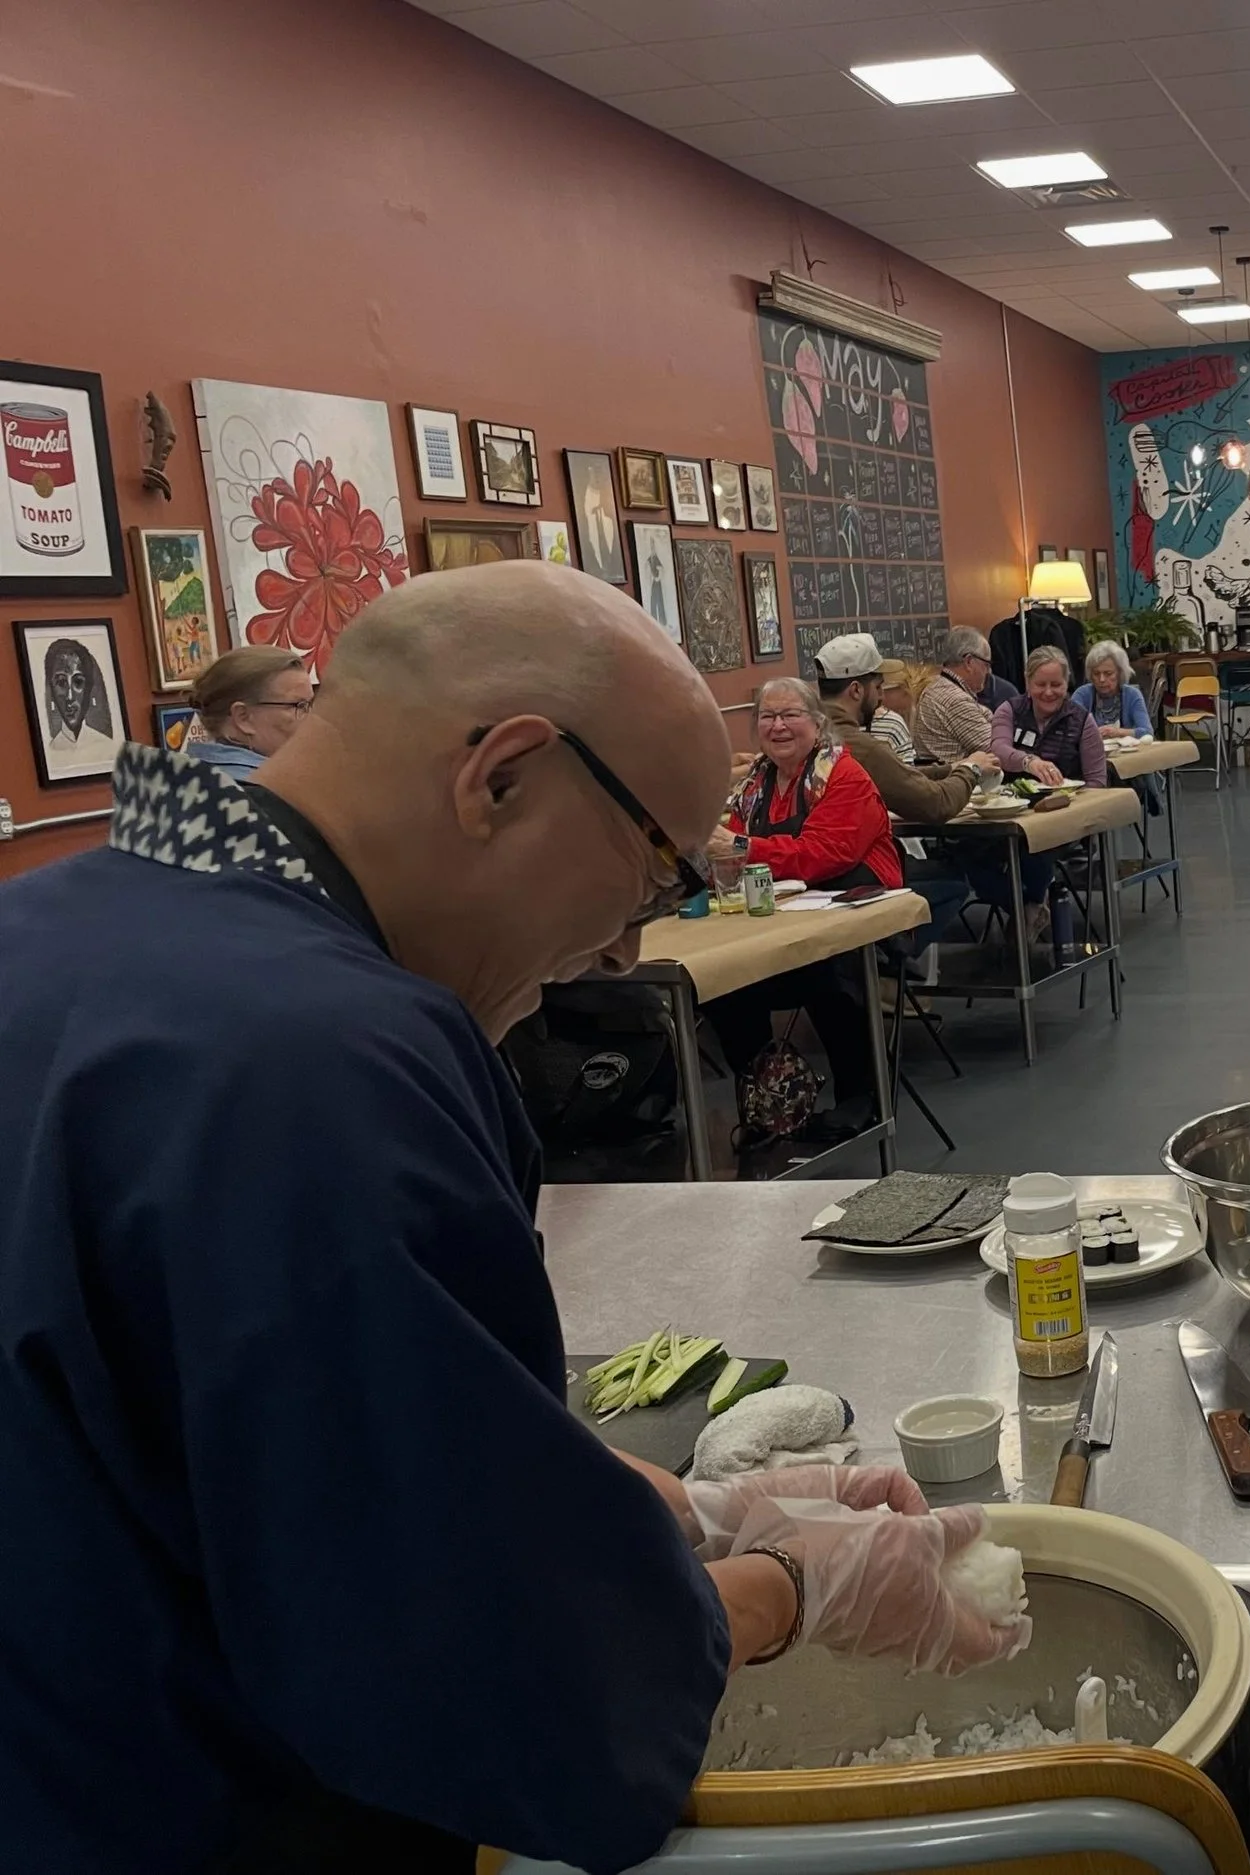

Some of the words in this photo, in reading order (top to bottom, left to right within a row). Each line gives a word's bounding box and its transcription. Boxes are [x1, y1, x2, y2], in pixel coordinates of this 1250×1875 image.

[817, 330, 882, 442] May
[21, 505, 73, 523] TOMATO
[30, 532, 70, 547] SOUP
[754, 878, 772, 888] IPA
